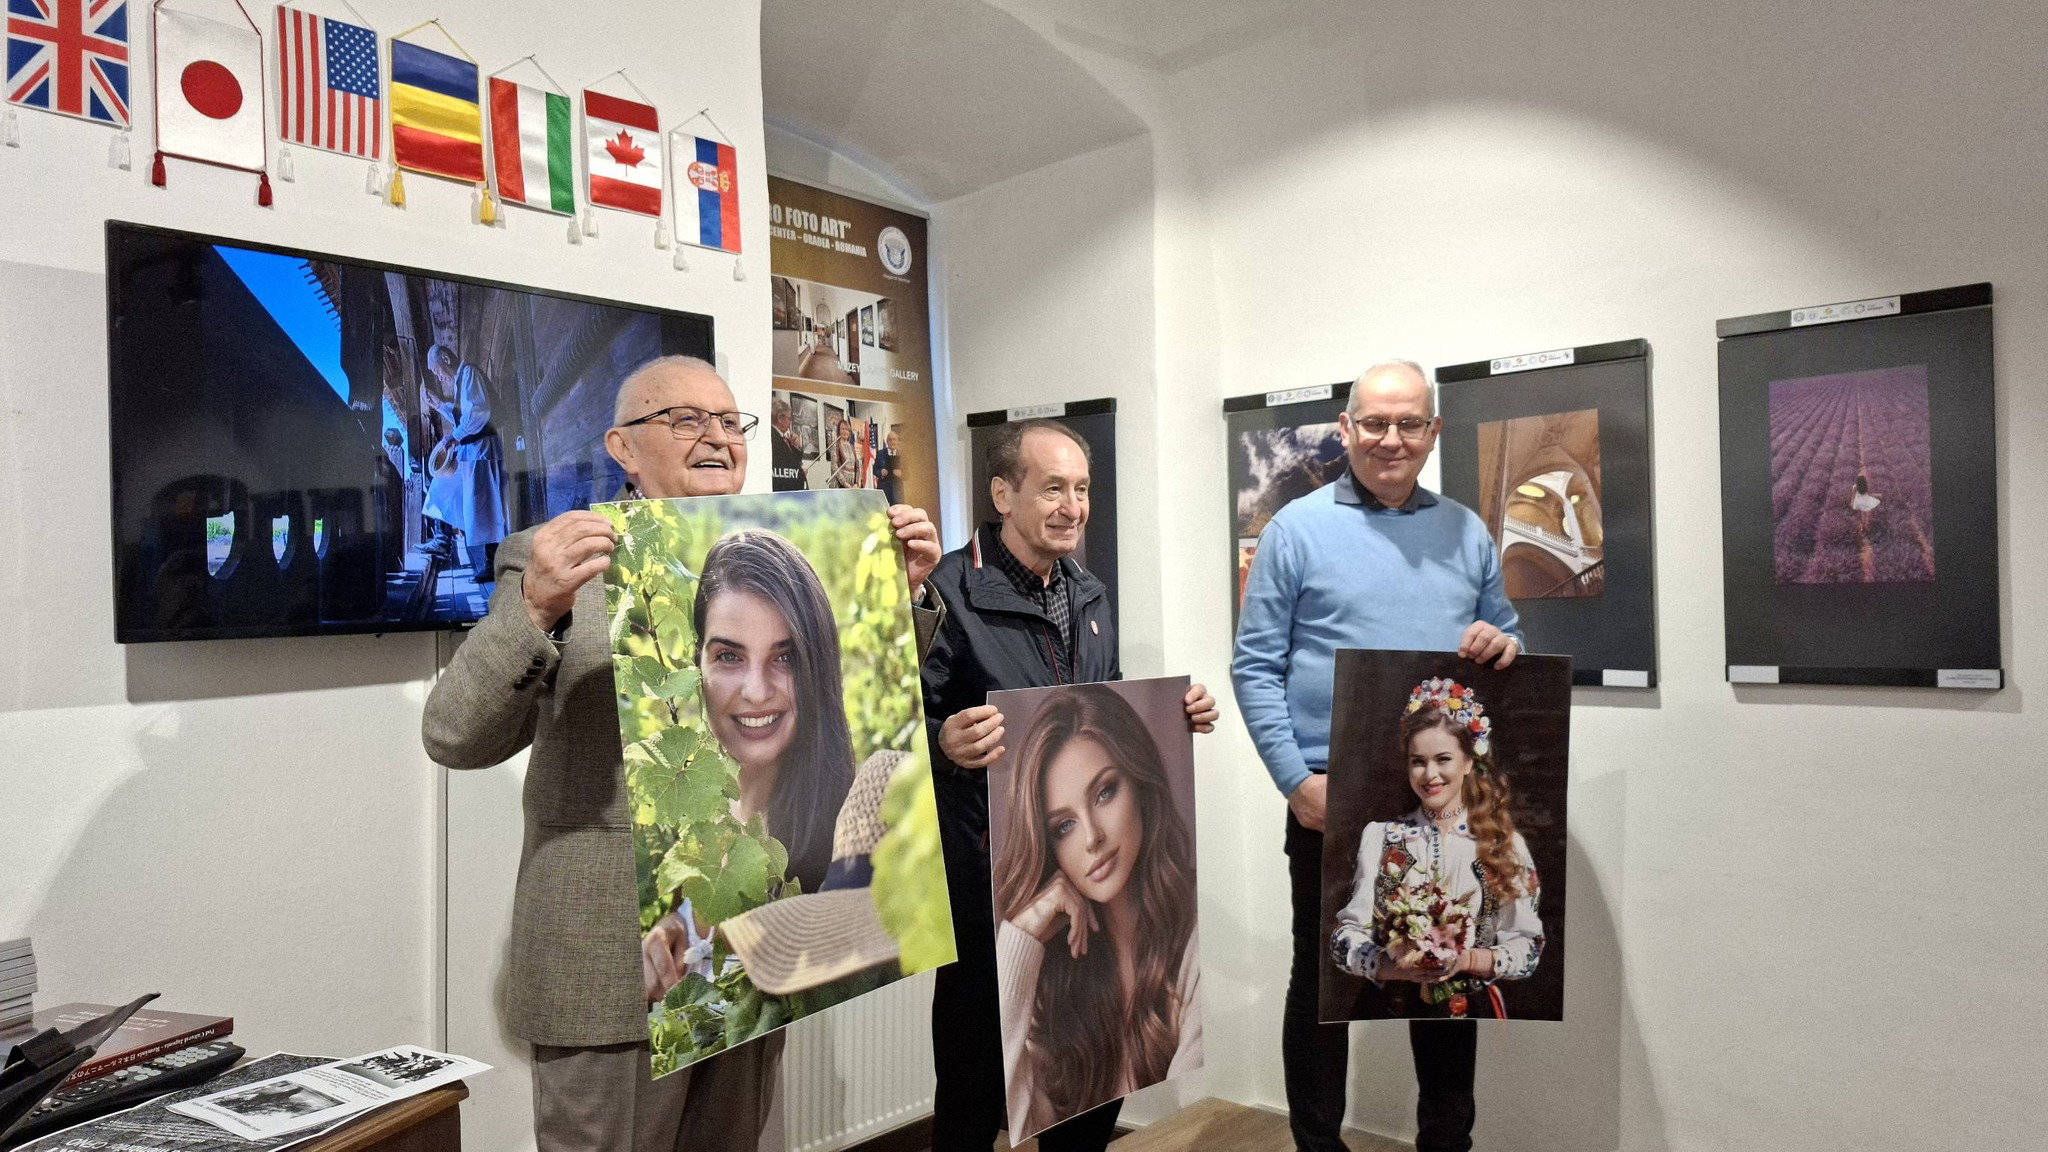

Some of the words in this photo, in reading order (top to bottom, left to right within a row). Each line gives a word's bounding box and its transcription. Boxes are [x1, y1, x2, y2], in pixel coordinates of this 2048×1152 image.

[785, 206, 819, 233] FOTO
[803, 233, 831, 250] ORADEA
[835, 240, 867, 257] ROMANIA
[890, 368, 919, 381] GALLERY
